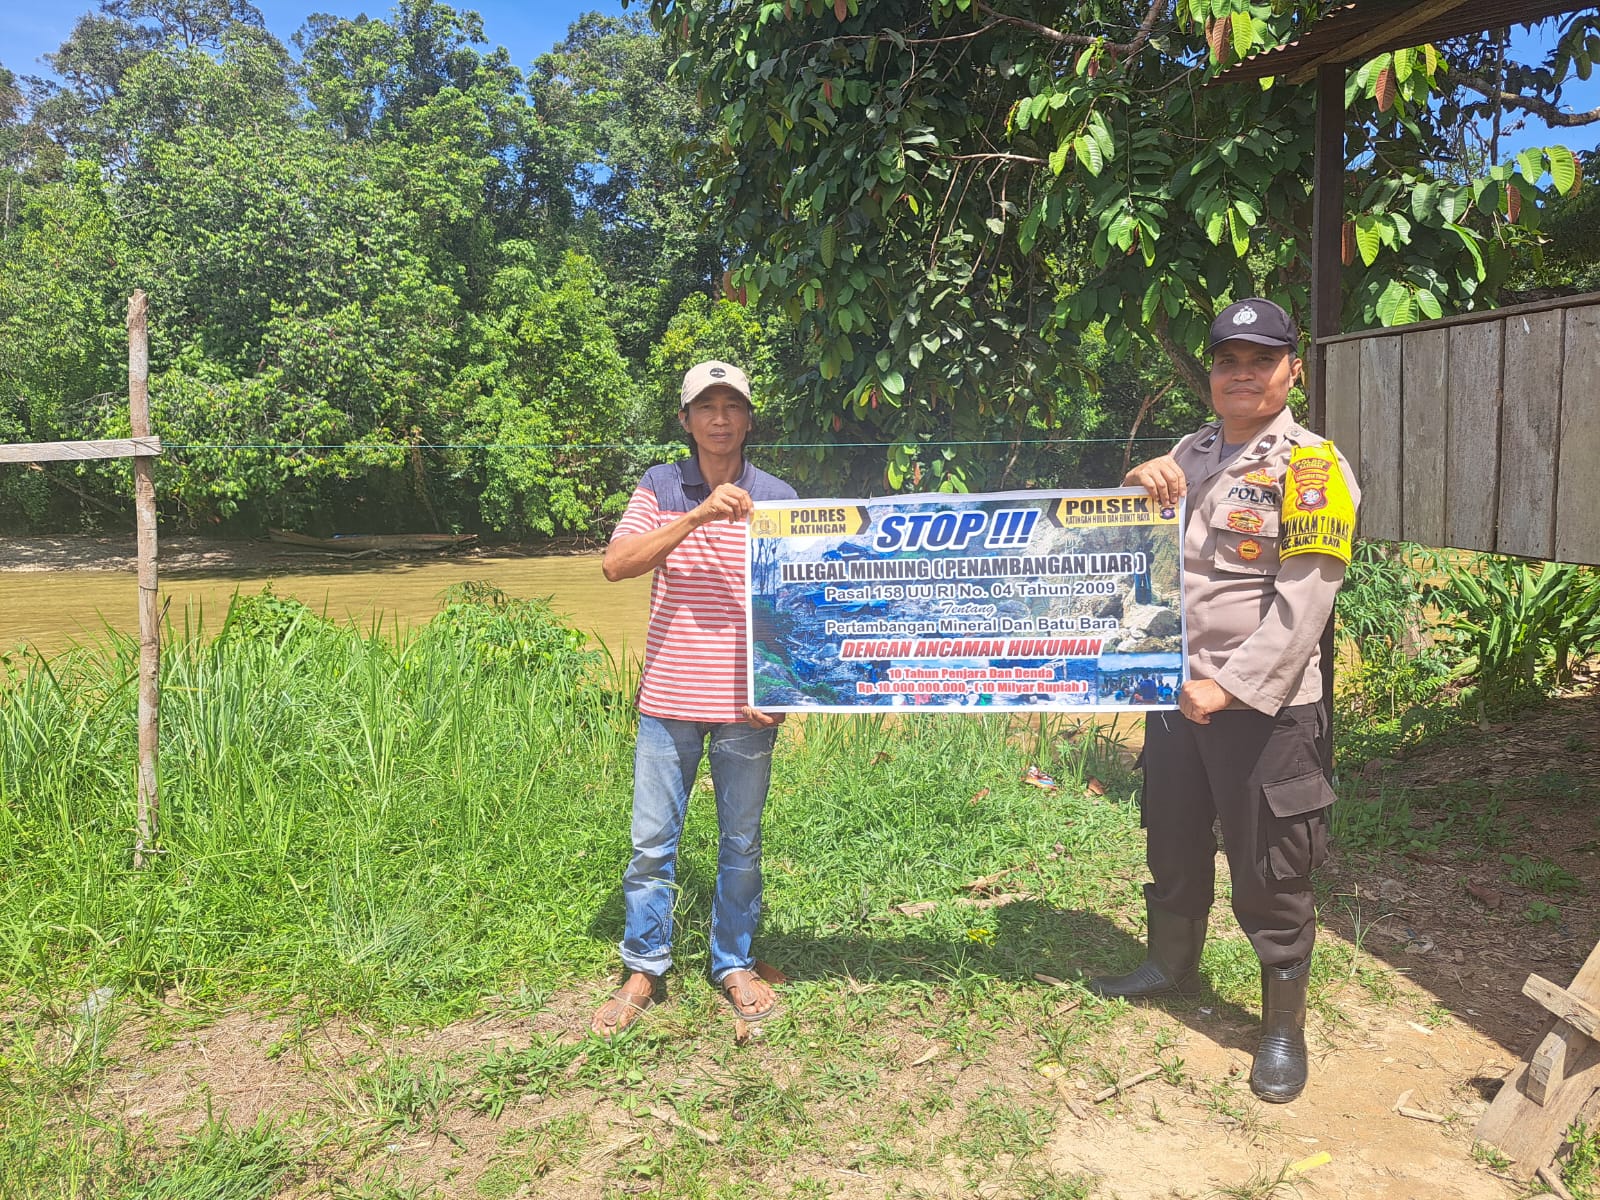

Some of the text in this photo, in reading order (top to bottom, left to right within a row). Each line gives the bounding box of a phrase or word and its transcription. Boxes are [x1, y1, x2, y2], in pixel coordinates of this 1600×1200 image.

[1228, 486, 1277, 504] POLRI
[1066, 498, 1148, 515] POLSEK
[790, 509, 846, 523] POLRES
[791, 524, 846, 535] KATINGAN
[1322, 536, 1340, 548] RAYA
[782, 562, 846, 581] ILLEGAL
[850, 560, 929, 580] MINNING
[826, 581, 1115, 600] Pasal 158 UU RI No. 04 Tahun 2009
[827, 617, 1117, 634] Pertambangan Mineral Dan Batu Bara
[842, 639, 1102, 658] DENGAN ANCAMAN HUKUMAN
[889, 667, 1052, 680] 10 Tahun Penjara Dan Denda
[858, 683, 875, 694] Rp.
[998, 682, 1033, 694] Milyar
